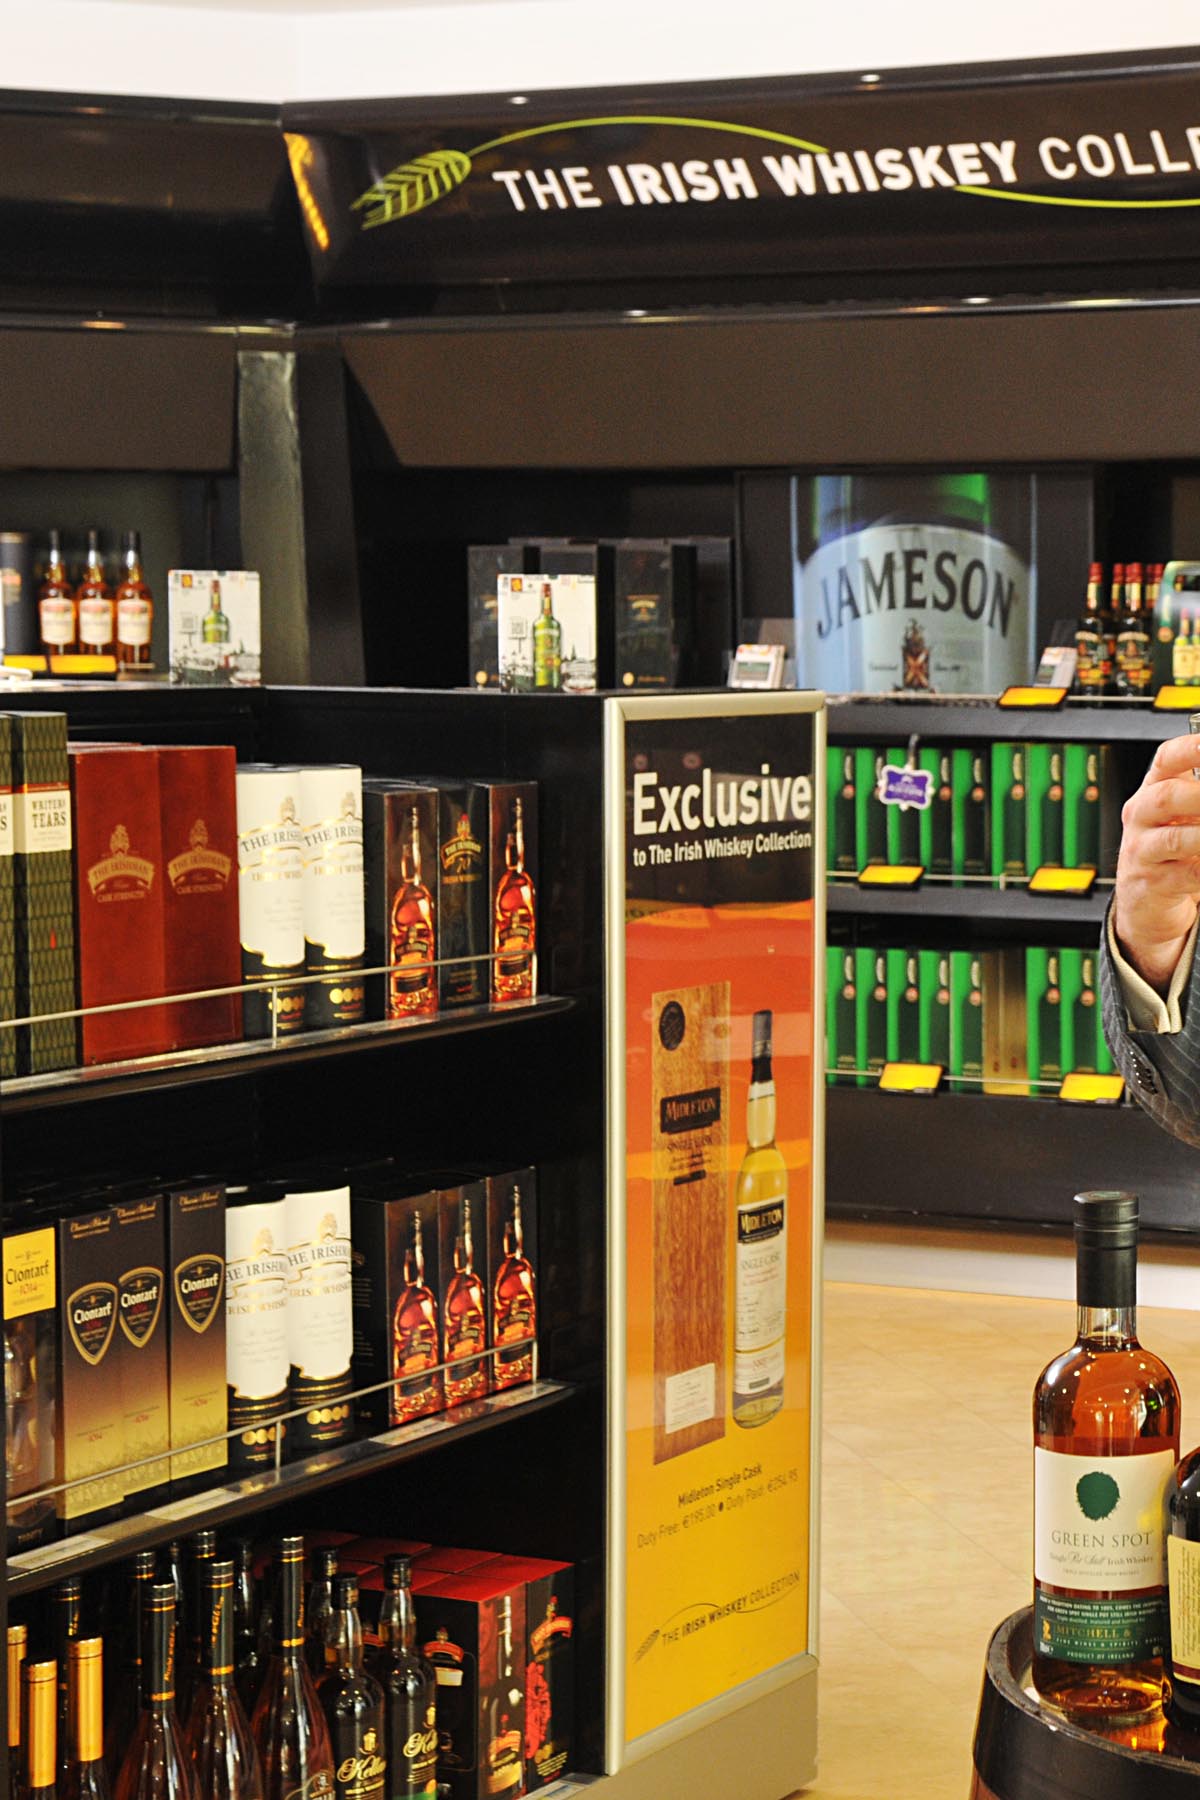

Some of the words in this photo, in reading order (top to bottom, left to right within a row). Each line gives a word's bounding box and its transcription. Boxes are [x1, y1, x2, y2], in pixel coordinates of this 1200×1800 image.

[493, 166, 602, 212] THE
[607, 155, 756, 206] IRISH
[763, 140, 1017, 198] WHISKEY
[817, 548, 1017, 641] JAMESON
[633, 763, 812, 836] Exclusive
[32, 812, 66, 828] TEARS
[304, 831, 332, 847] THE
[633, 849, 646, 867] to
[648, 844, 672, 866] The
[674, 841, 703, 862] Irish
[704, 836, 754, 859] Whiskey
[755, 830, 812, 853] Collection
[665, 1097, 716, 1122] MIDLETON
[740, 1207, 782, 1234] MIDLETON
[5, 1259, 51, 1286] Clontarf
[288, 1254, 308, 1267] HE
[181, 1273, 220, 1295] Clontarf
[120, 1286, 158, 1308] Clontarf
[73, 1302, 112, 1325] Clontarf
[678, 1484, 715, 1508] Midleton
[716, 1473, 741, 1492] Single
[743, 1464, 762, 1481] Cask
[1051, 1530, 1105, 1548] GREEN
[1112, 1532, 1153, 1548] SPOT
[662, 1627, 680, 1646] THE
[682, 1615, 706, 1638] IRISH
[709, 1595, 748, 1624] WHISKEY
[750, 1569, 800, 1604] COLLECTION
[1054, 1624, 1119, 1639] MITCHELL
